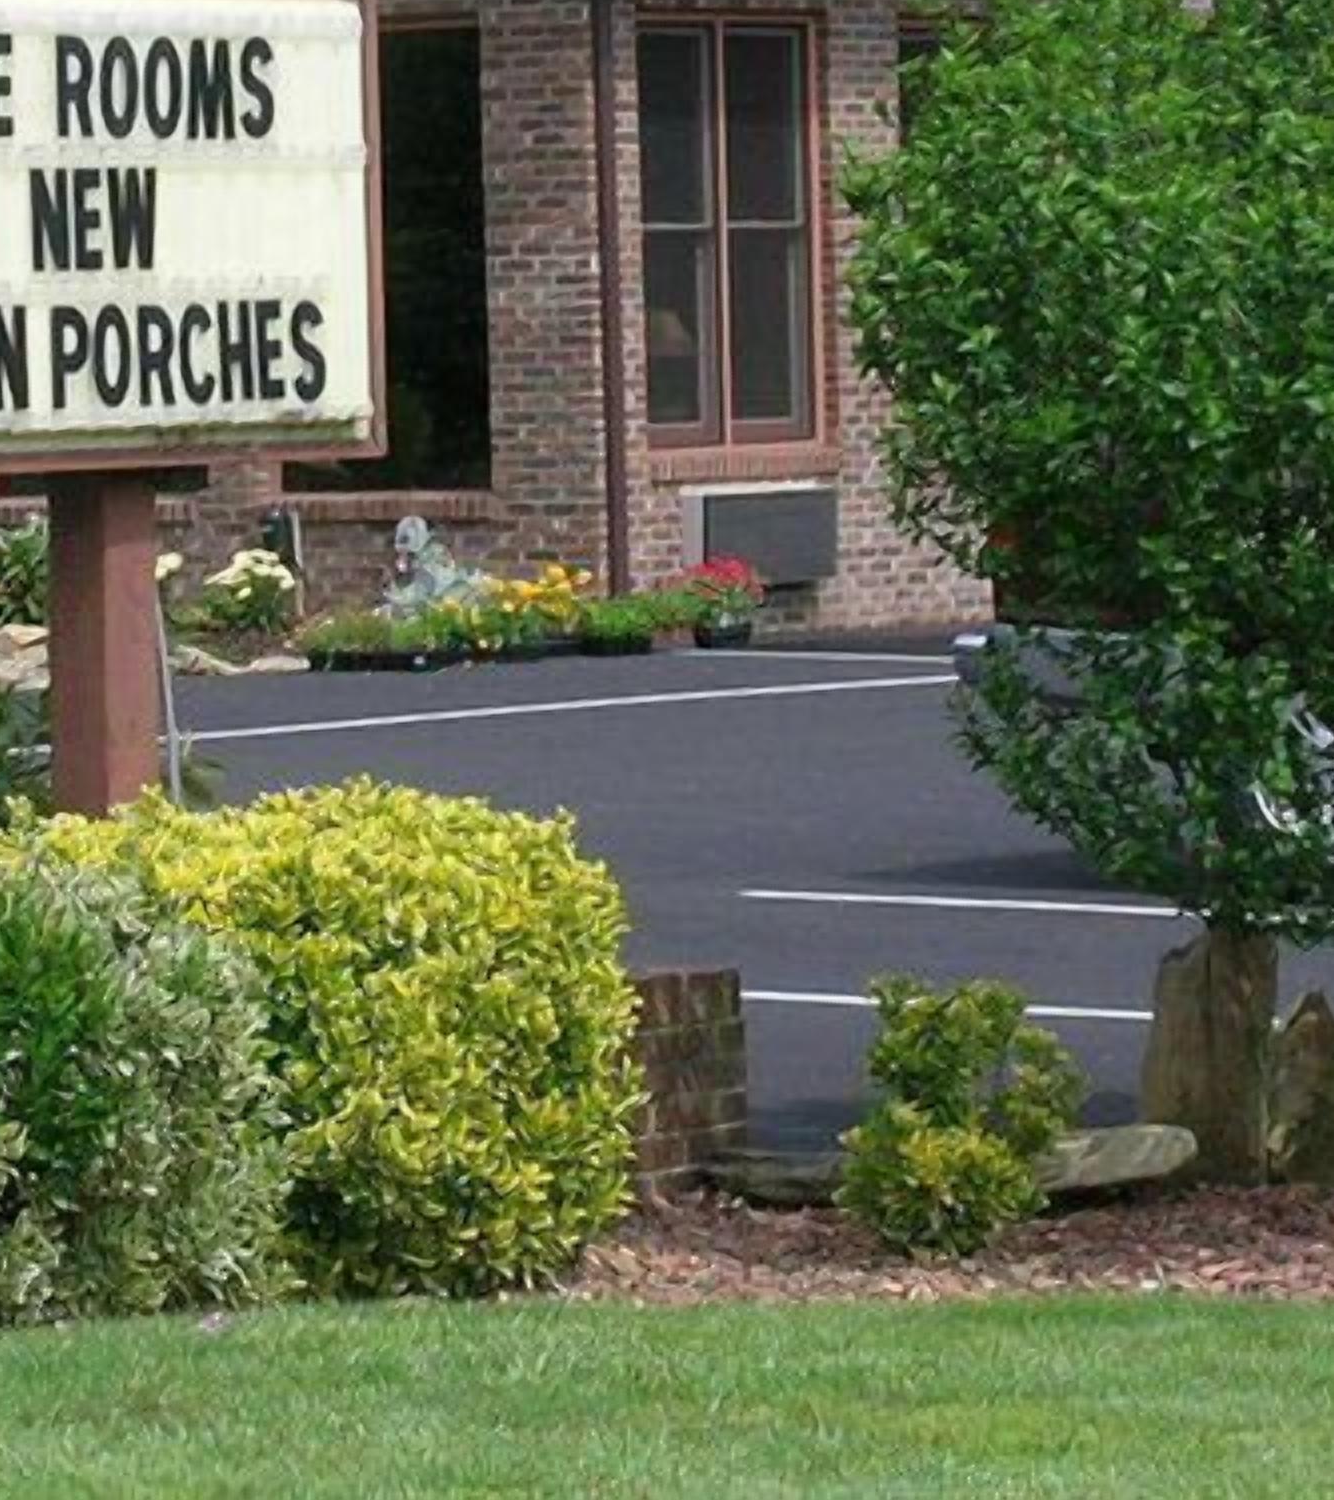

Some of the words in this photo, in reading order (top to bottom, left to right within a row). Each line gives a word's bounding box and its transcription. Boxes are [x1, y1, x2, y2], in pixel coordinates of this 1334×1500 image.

[55, 35, 275, 140] ROOMS
[29, 167, 157, 272] NEW
[50, 299, 327, 411] PORCHES
